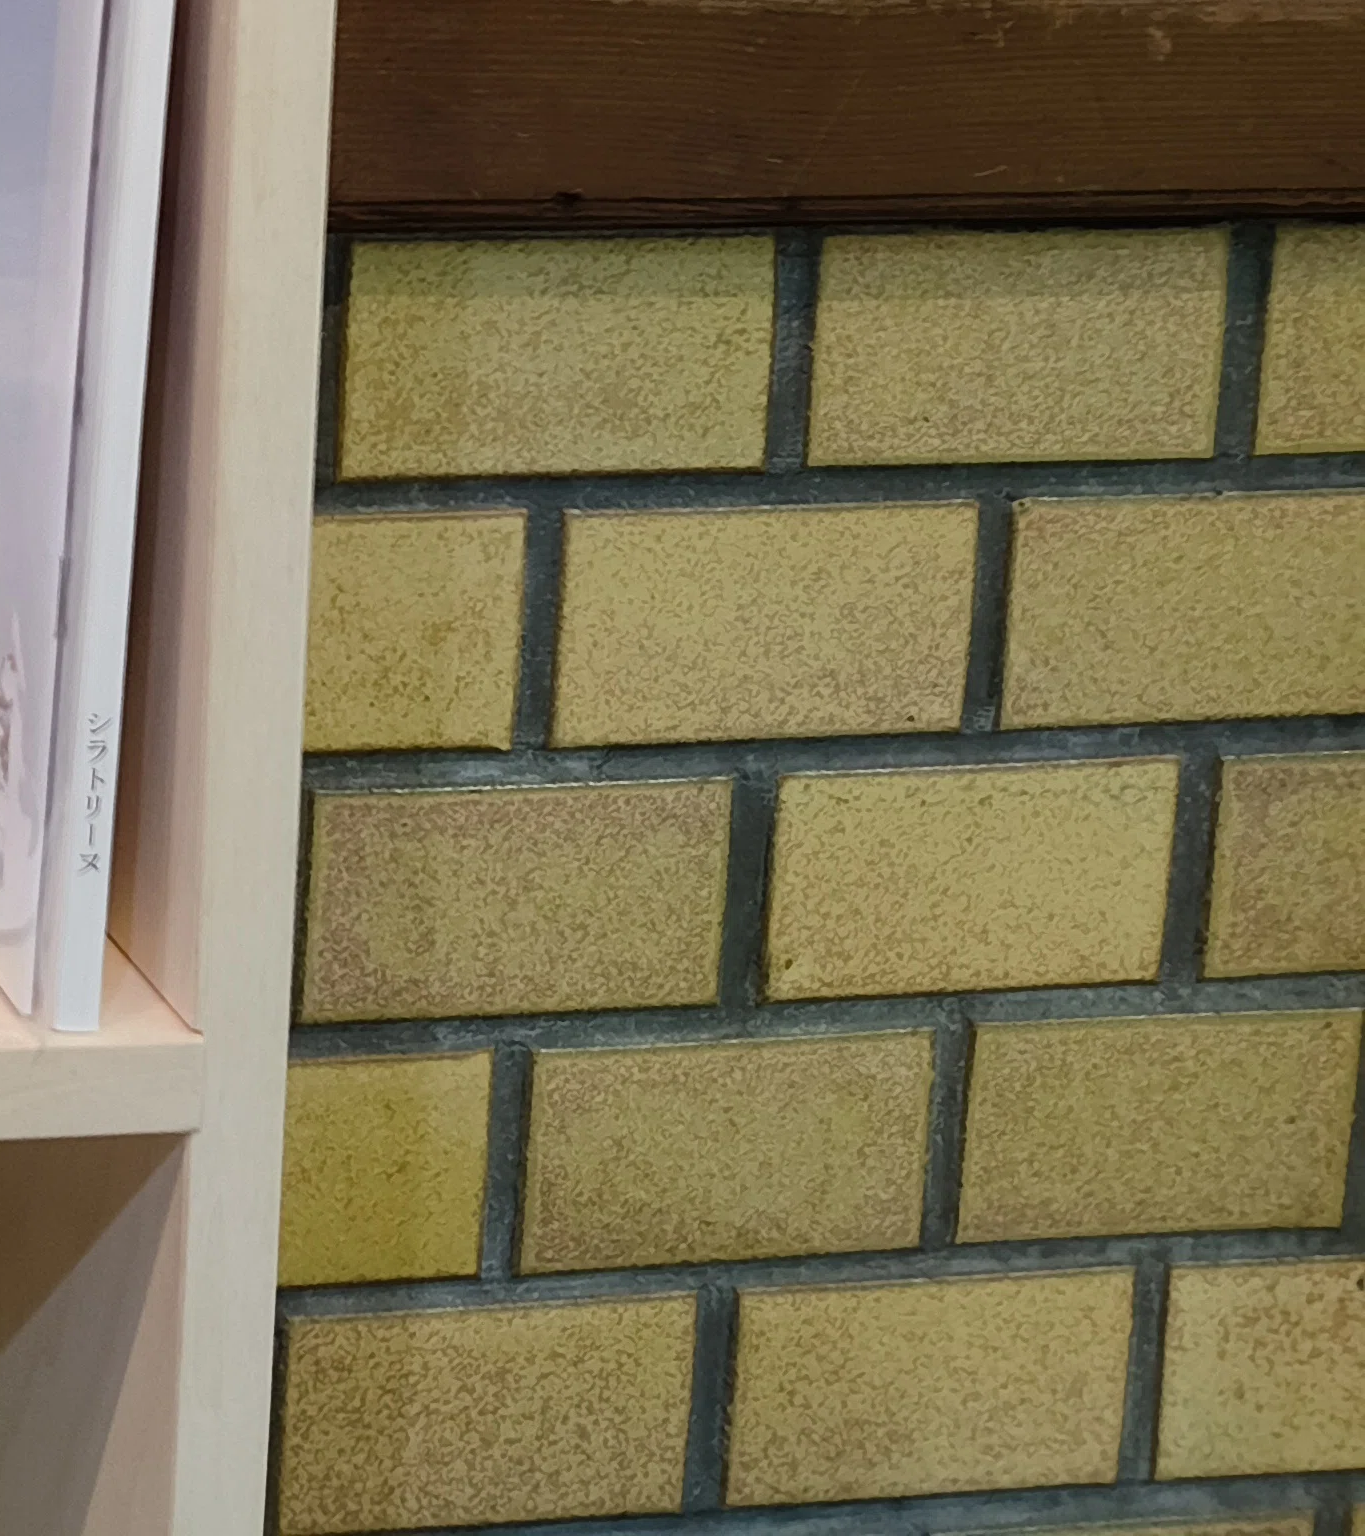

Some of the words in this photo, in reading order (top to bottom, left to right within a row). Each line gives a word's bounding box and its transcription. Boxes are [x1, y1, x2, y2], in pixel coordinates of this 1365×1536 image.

[76, 712, 113, 875] シラトリーヌ
